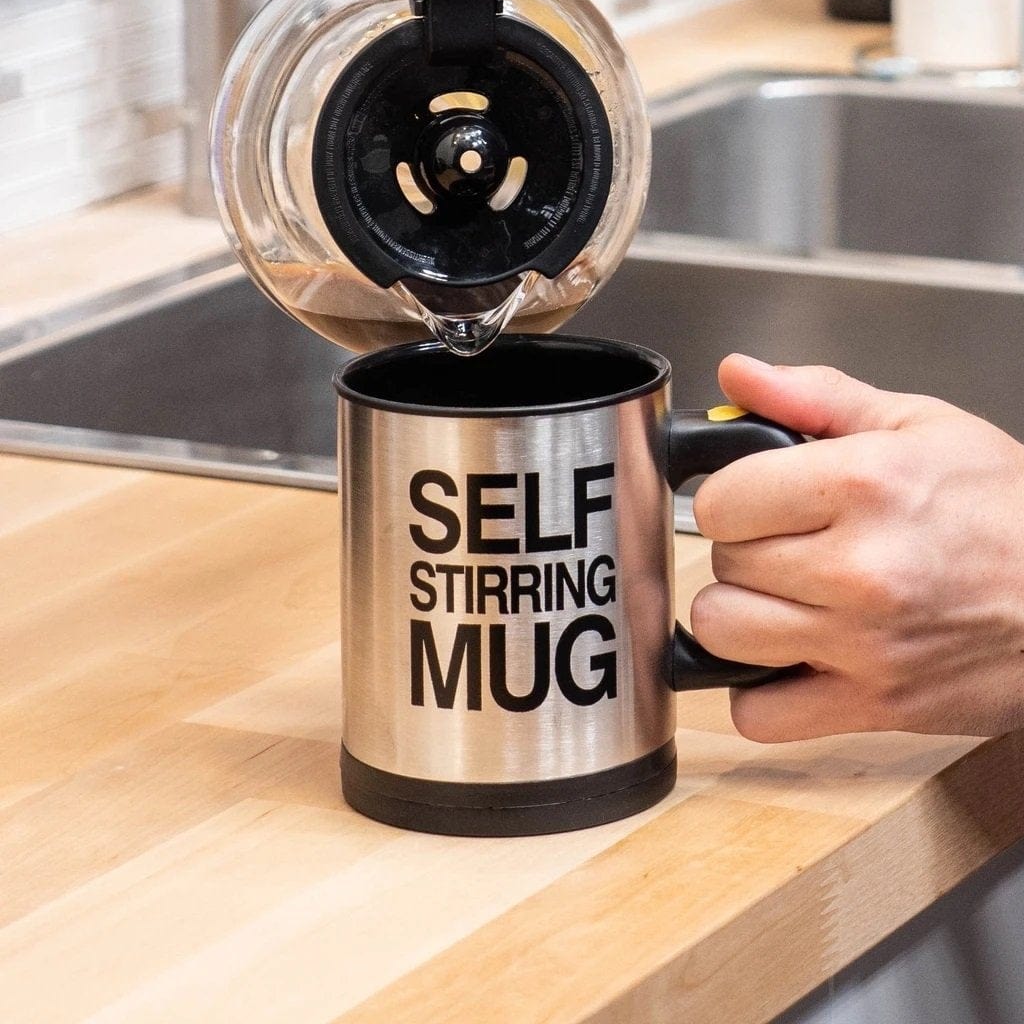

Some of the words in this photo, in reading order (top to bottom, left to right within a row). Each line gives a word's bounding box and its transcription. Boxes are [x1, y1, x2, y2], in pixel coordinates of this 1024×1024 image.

[409, 462, 615, 555] SELF
[409, 554, 617, 615] STIRRING
[410, 614, 618, 713] MUG
